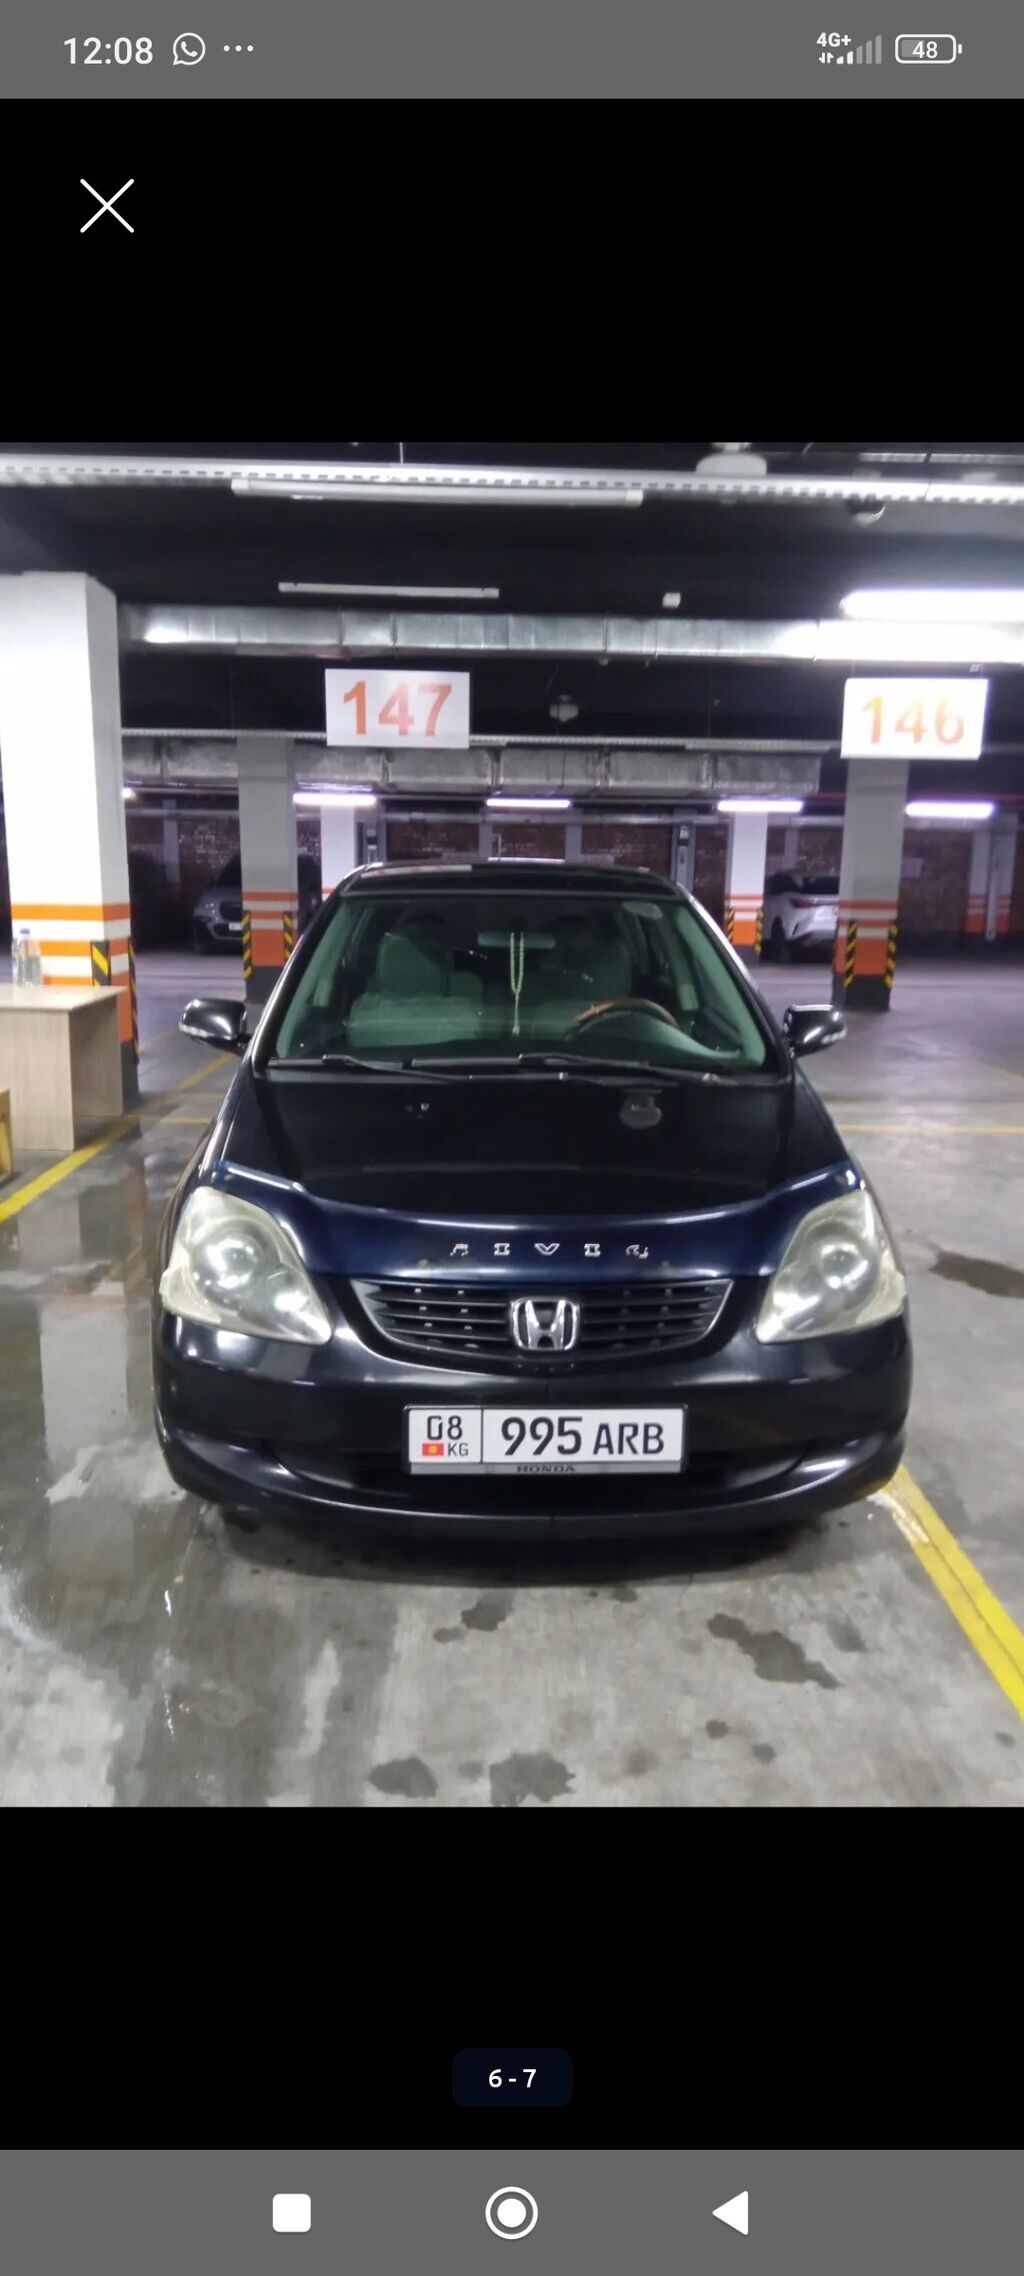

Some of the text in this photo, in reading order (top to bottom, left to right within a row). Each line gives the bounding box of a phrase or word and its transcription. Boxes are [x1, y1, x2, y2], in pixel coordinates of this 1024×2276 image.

[343, 680, 452, 736] 147
[861, 695, 964, 745] 146
[426, 1415, 463, 1441] 08
[501, 1416, 665, 1456] 995 ARB
[447, 1443, 469, 1457] KG
[516, 1464, 576, 1473] HONDA
